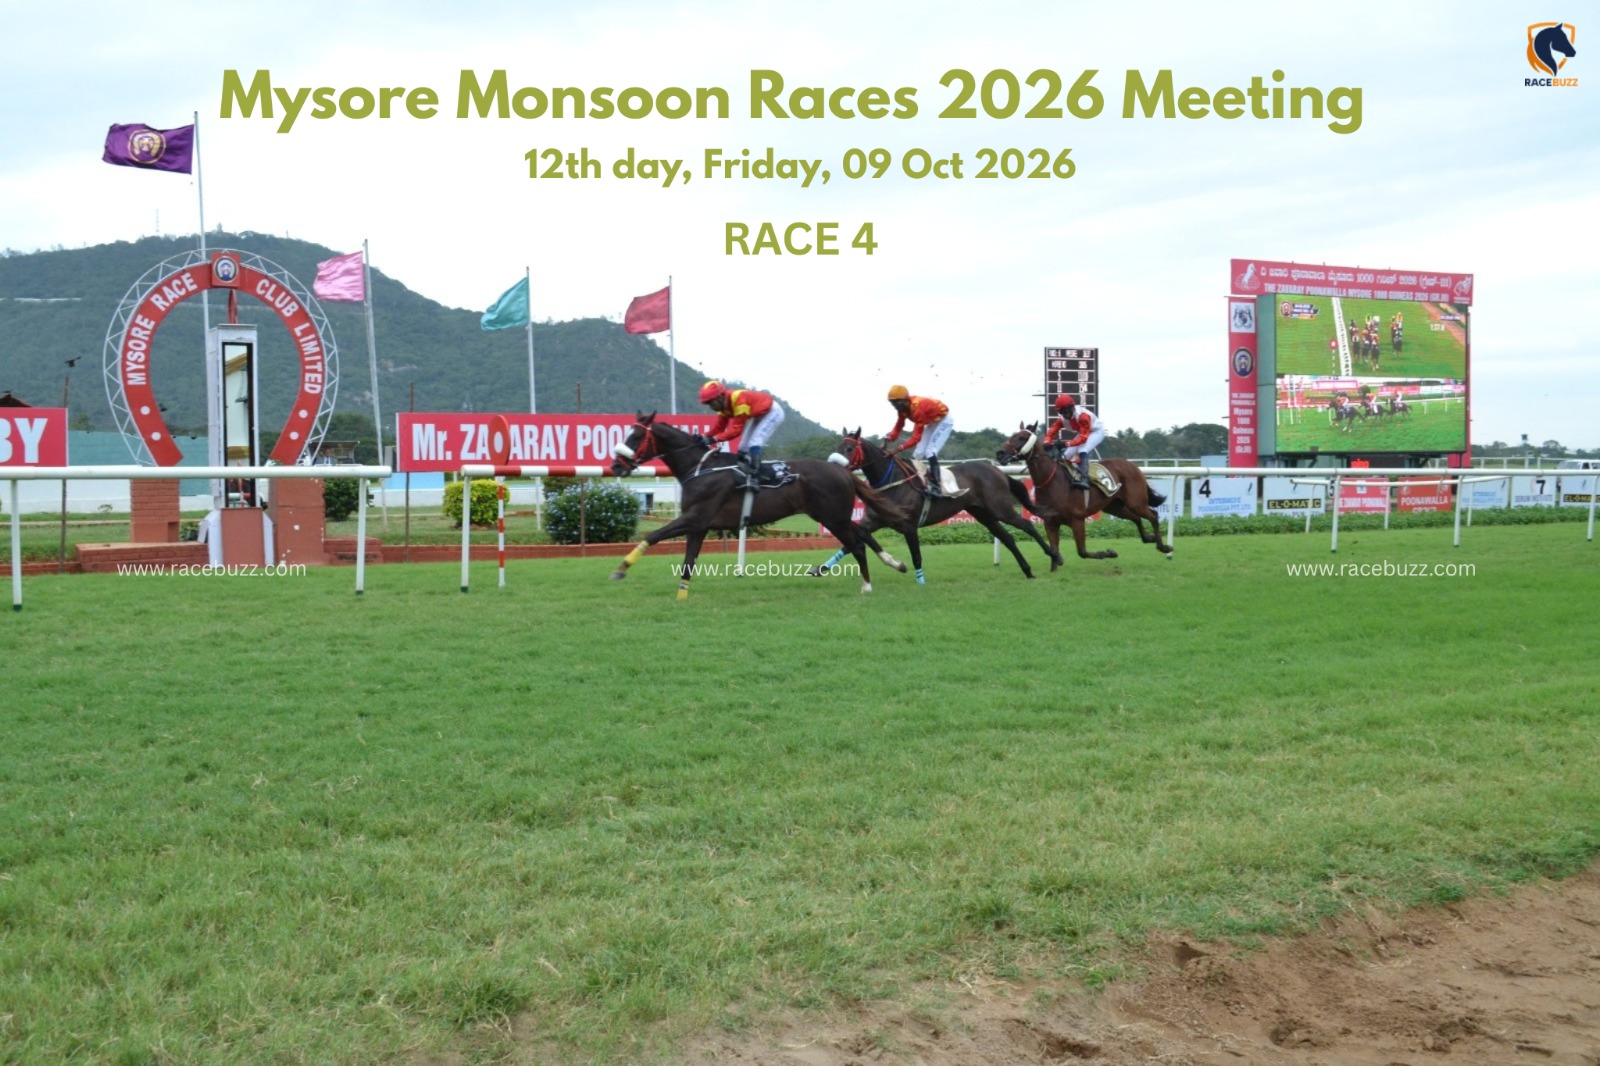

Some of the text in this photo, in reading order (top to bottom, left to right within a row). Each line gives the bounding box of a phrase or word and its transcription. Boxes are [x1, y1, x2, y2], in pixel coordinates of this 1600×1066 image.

[126, 272, 198, 386] MYSORE RACE
[256, 279, 322, 394] CLUB LIMITED
[412, 423, 452, 461] Mr.
[460, 424, 570, 460] ZAARAY
[1199, 480, 1211, 498] 4
[1536, 480, 1546, 494] 7
[1269, 500, 1321, 509] EL-O-MATC
[1401, 496, 1448, 505] POONAWALLA
